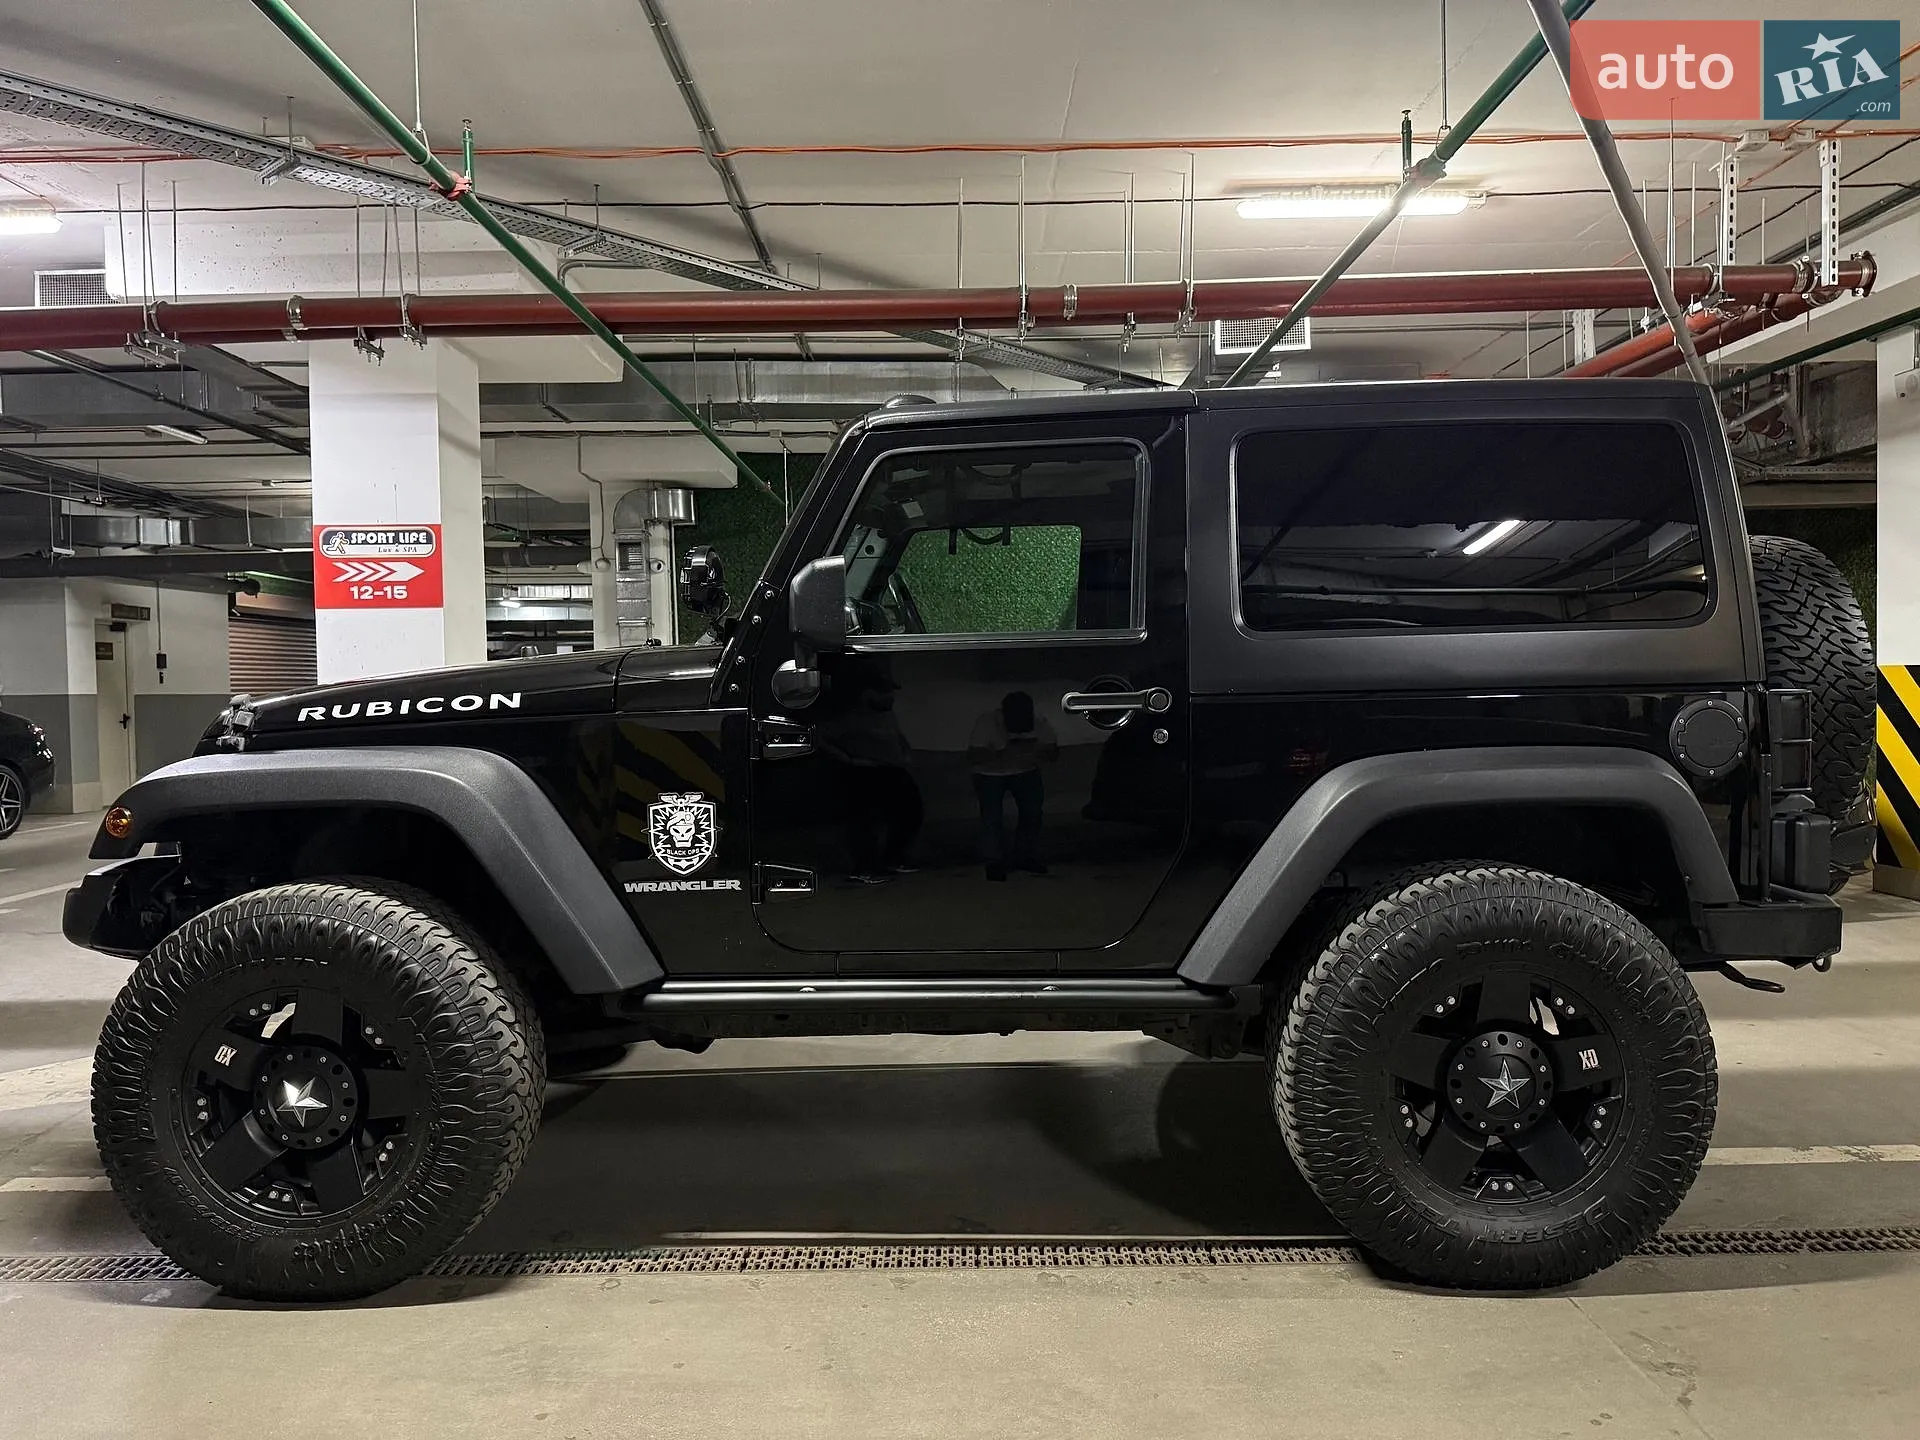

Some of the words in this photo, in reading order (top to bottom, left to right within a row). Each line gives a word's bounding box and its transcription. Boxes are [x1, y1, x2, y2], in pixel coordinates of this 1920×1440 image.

[351, 532, 396, 544] SPORT
[398, 532, 427, 544] LIFE
[349, 585, 408, 600] 12-15
[297, 692, 522, 722] RUBICON
[666, 848, 687, 856] BLACK
[688, 848, 700, 856] OPS
[624, 878, 742, 893] WRANGLER
[1578, 1048, 1600, 1070] XD
